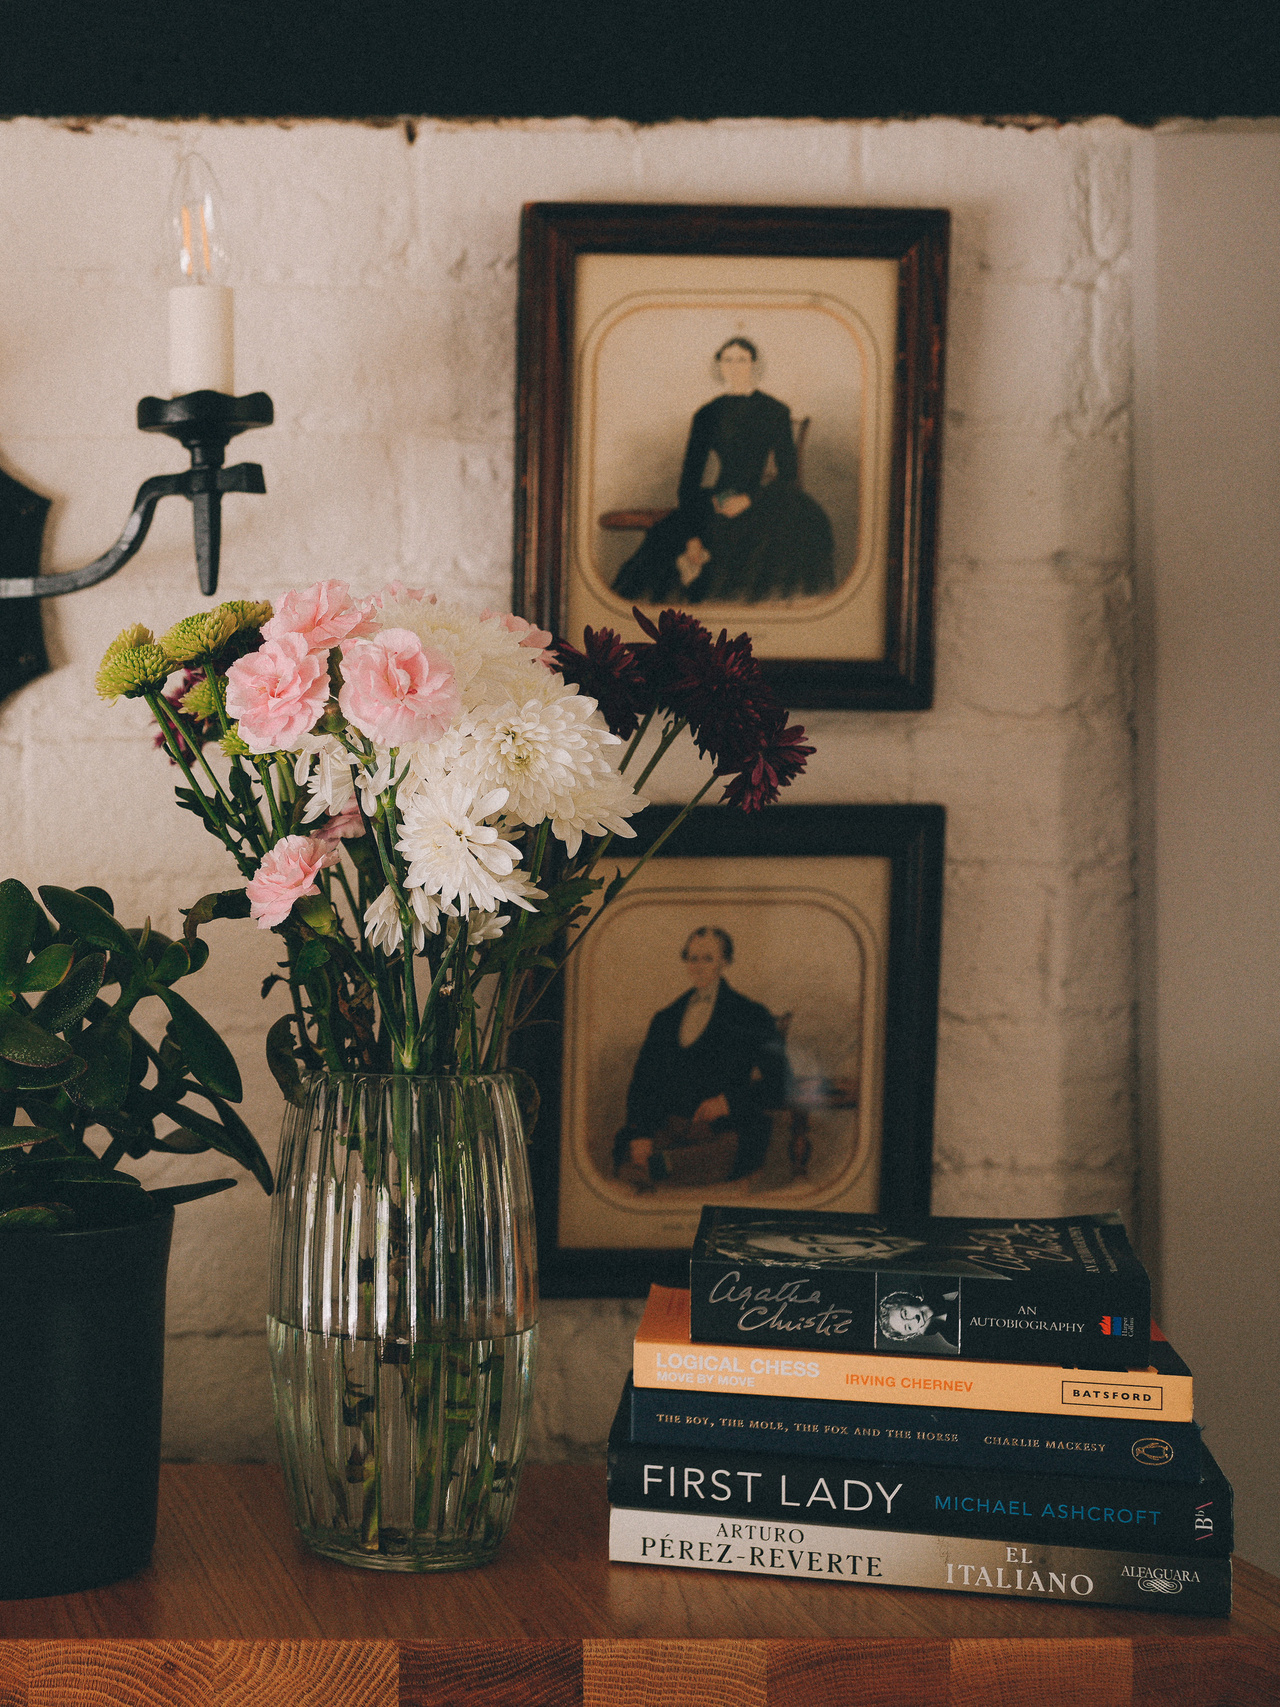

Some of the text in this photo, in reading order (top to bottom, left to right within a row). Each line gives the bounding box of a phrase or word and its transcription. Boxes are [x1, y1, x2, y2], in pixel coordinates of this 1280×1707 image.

[709, 1271, 820, 1310] Agatha
[737, 1302, 853, 1336] Christie
[1018, 1305, 1037, 1315] AN
[970, 1317, 1085, 1332] AUTOBIOGRAPHY
[657, 1352, 820, 1378] LOGICAL CHESS
[657, 1371, 755, 1387] MOVE BY MOVE
[845, 1373, 974, 1392] IRVING CHERNEV
[1073, 1389, 1152, 1402] BATSFORD
[656, 1413, 959, 1442] THE BOY, THE MOLE, THE FOX AND THE HORSE
[984, 1435, 1106, 1452] CHARLIE MACKESY
[643, 1464, 903, 1514] FIRST LADY
[935, 1495, 1161, 1525] MICHAEL ASHCROFT
[716, 1523, 805, 1544] ARTURO
[641, 1534, 883, 1577] PÉREZ-REVERTE
[1006, 1547, 1032, 1564] EL
[946, 1563, 1094, 1596] ITALIANO
[1121, 1566, 1201, 1583] ALFAGUARA
